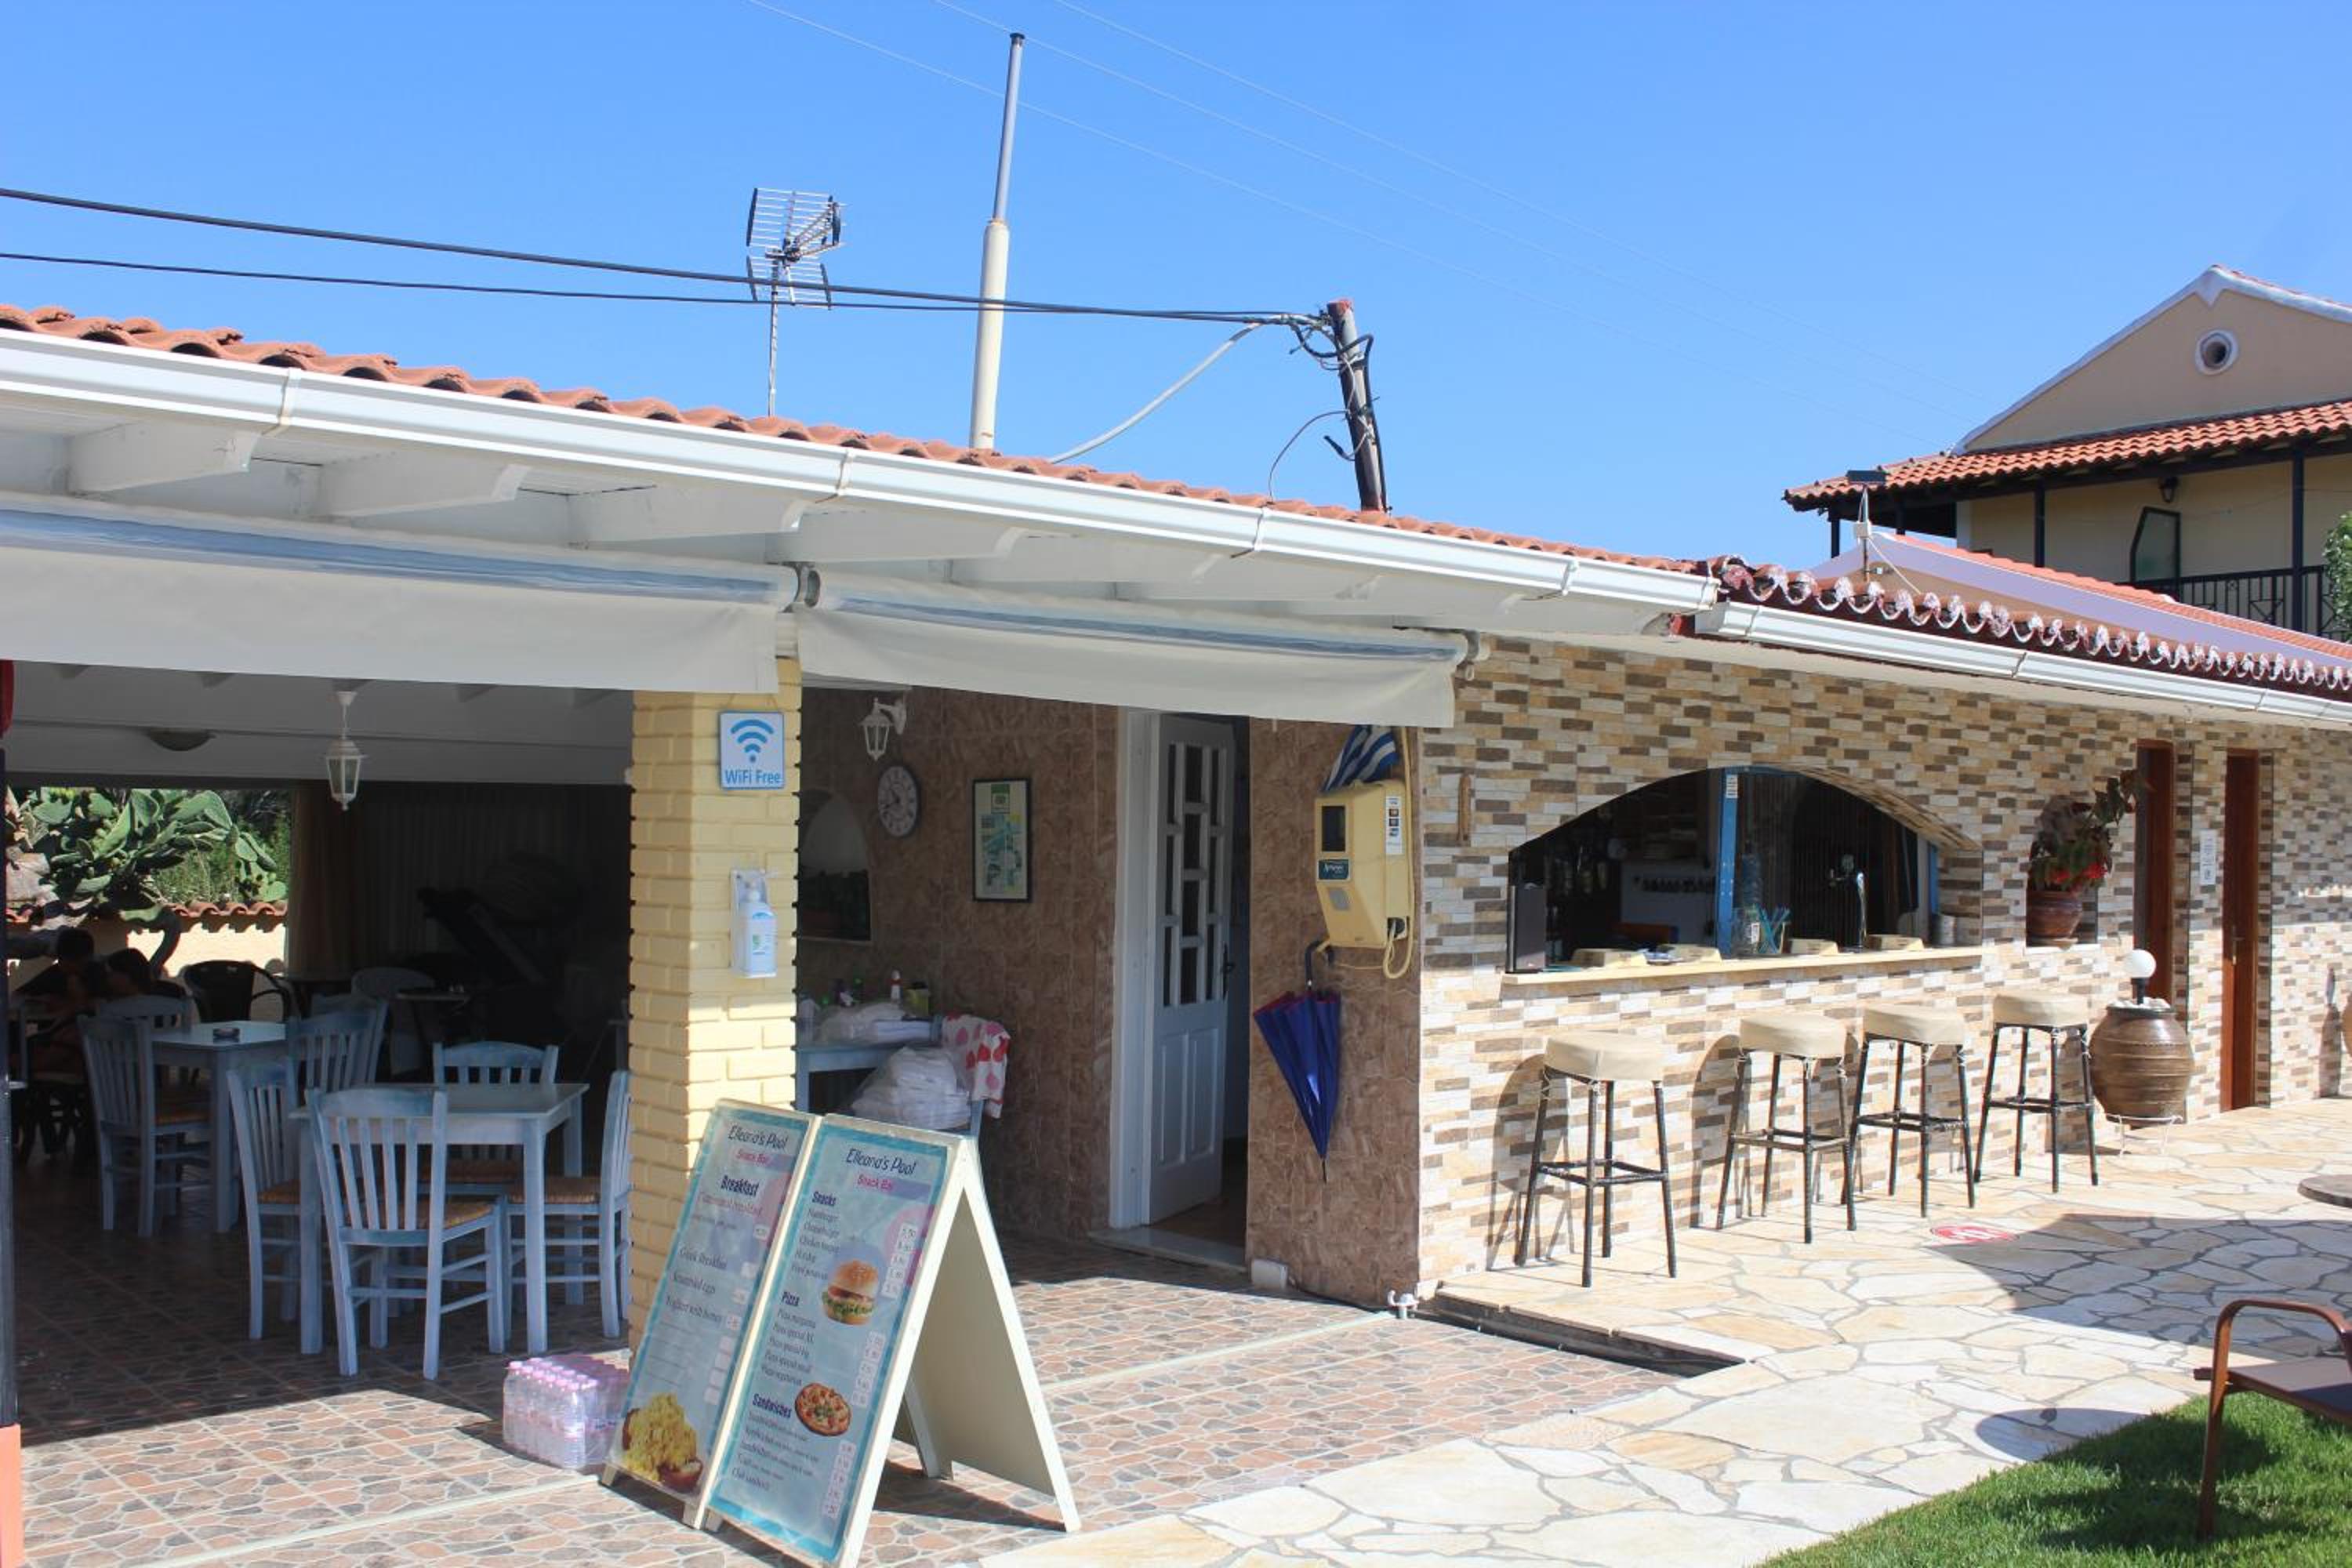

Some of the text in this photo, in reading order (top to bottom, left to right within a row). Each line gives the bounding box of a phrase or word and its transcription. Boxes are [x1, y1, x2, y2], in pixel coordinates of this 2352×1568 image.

[725, 768, 780, 784] WiFi Free
[765, 1132, 789, 1149] Pool
[890, 1156, 916, 1175] Pool
[720, 1174, 760, 1197] Breakfast
[858, 1174, 879, 1189] Snack
[811, 1191, 837, 1207] Snacks
[781, 1291, 800, 1307] Pizza
